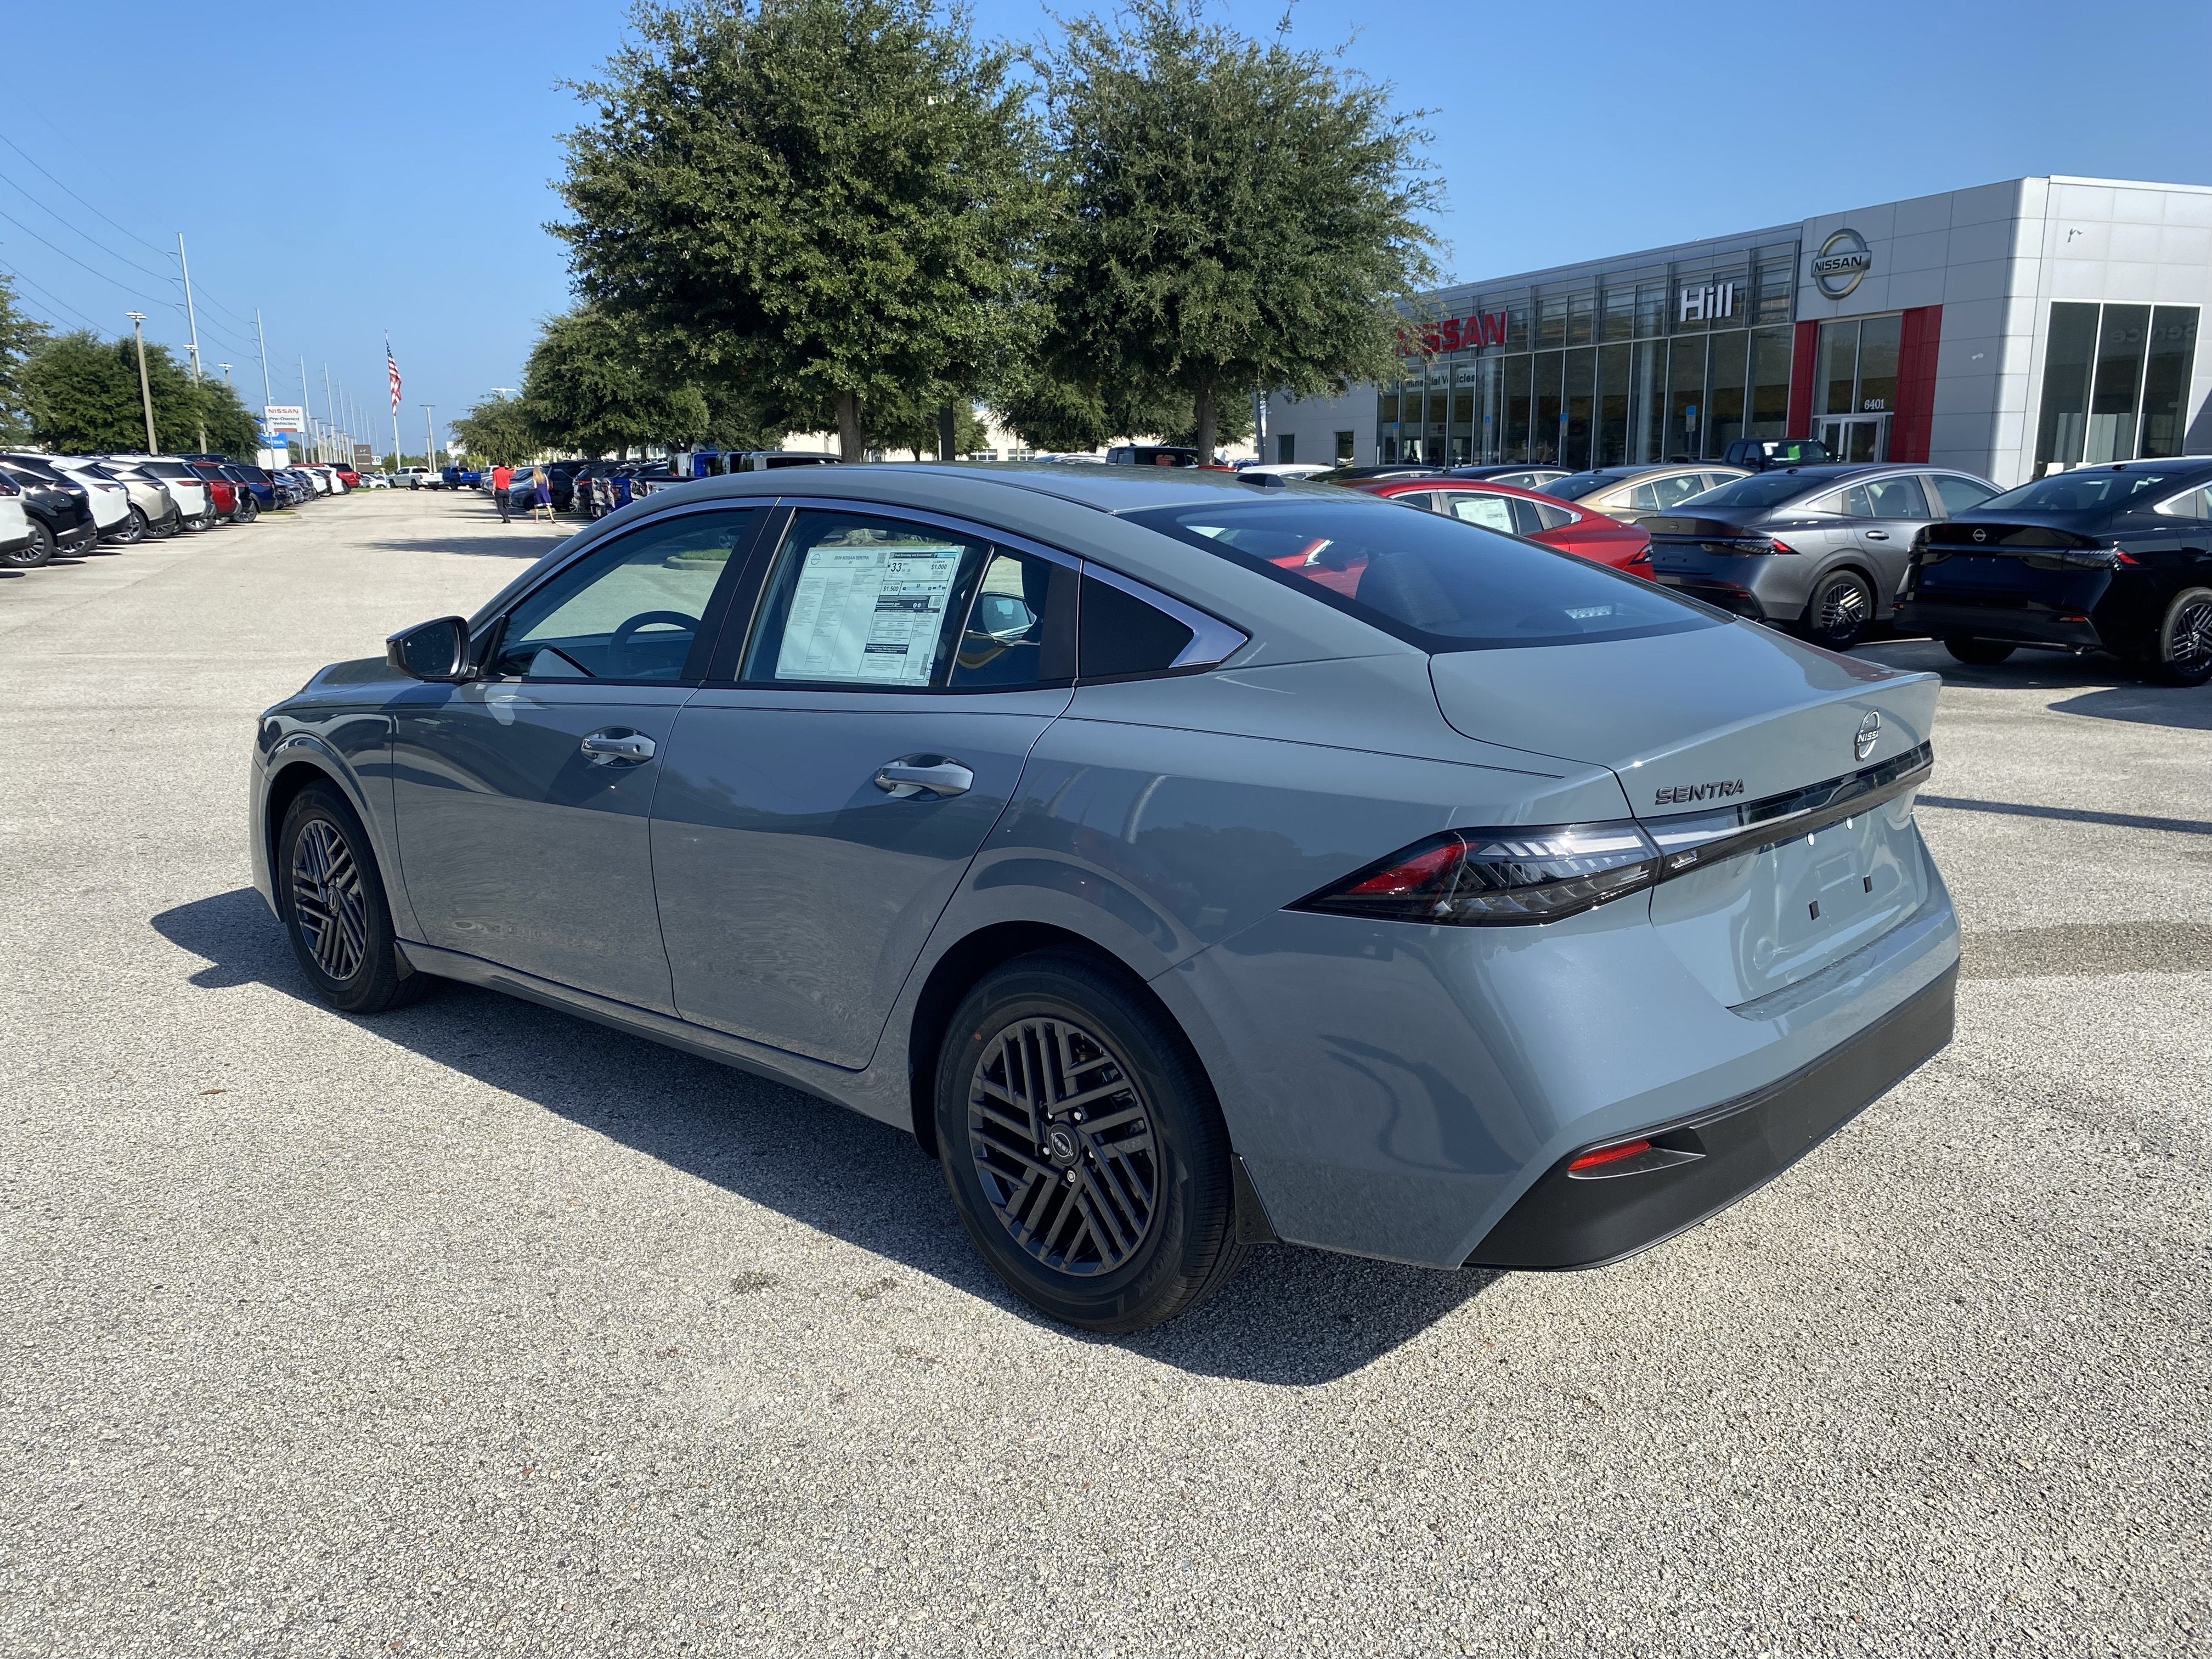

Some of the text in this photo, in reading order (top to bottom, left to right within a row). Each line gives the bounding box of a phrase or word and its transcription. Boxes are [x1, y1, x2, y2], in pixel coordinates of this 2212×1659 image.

[1814, 256, 1862, 273] NISSAN
[1680, 283, 1735, 322] Hill
[1395, 311, 1506, 357] SSAN
[1396, 373, 1475, 390] Cmmeial Vicles
[1864, 398, 1884, 410] 6401
[890, 562, 902, 572] 33
[1857, 730, 1879, 743] NISS
[1655, 778, 1745, 805] SENTRA
[1051, 1132, 1074, 1156] NISSAN
